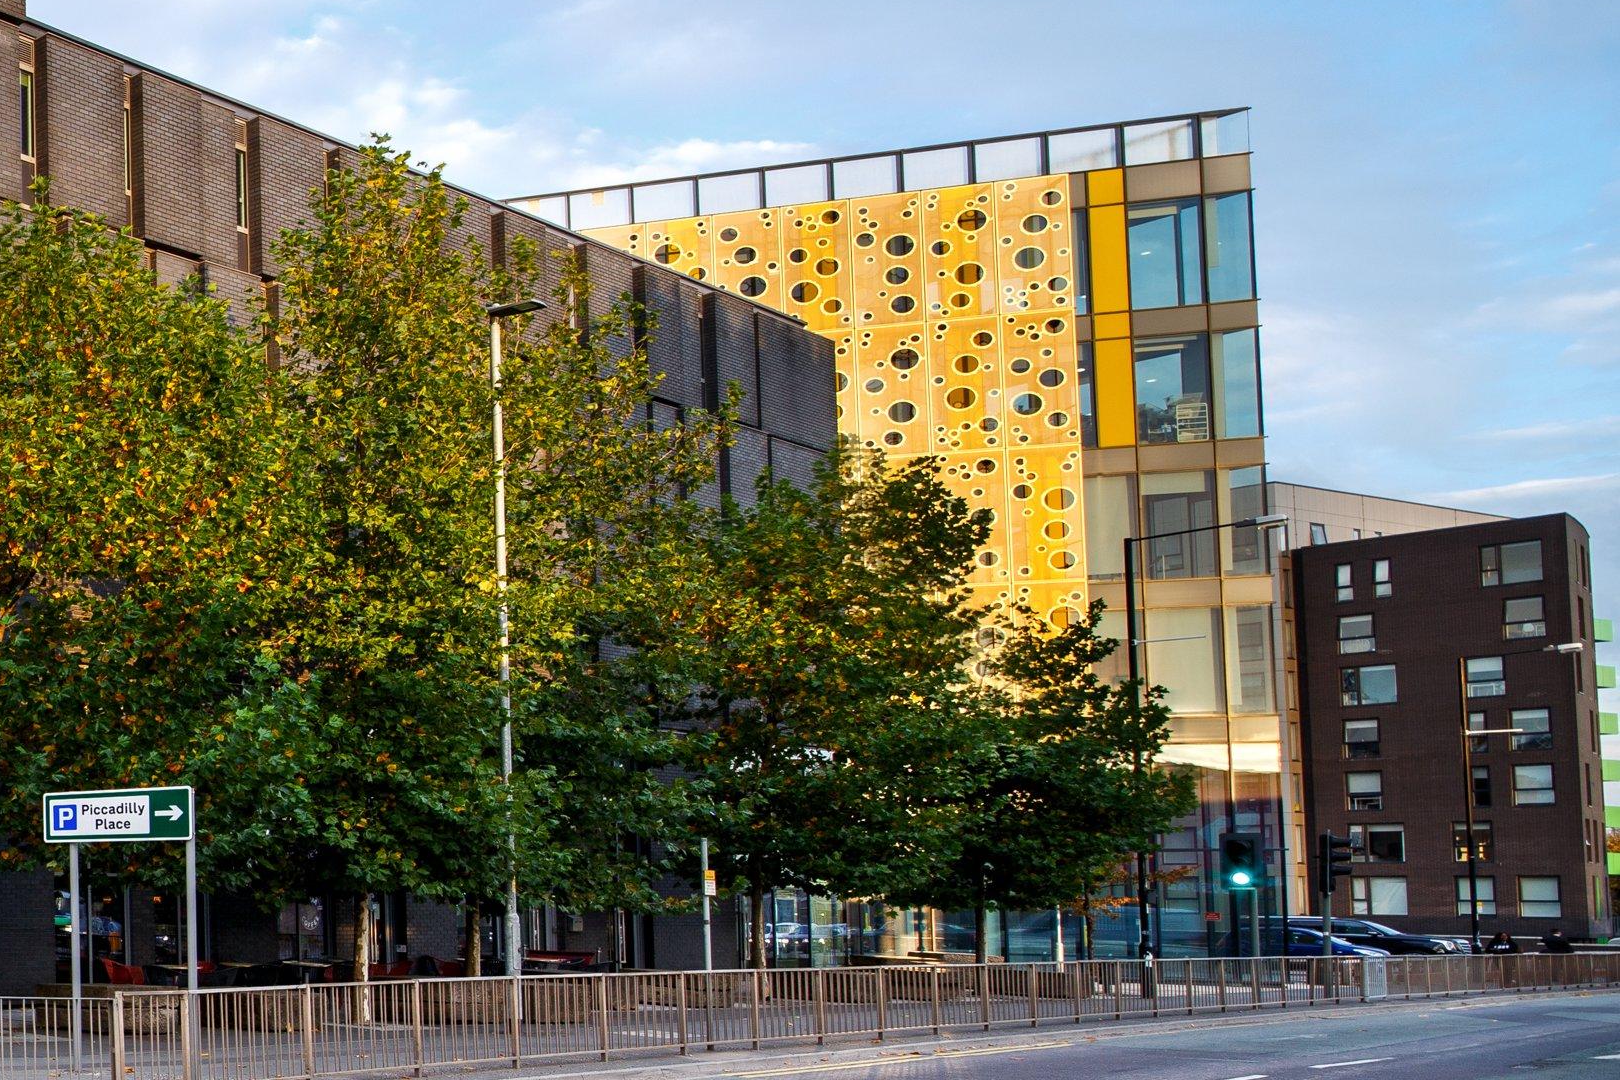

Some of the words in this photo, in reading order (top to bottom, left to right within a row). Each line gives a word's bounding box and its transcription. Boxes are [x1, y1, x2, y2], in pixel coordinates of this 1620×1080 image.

[59, 807, 74, 829] P
[81, 802, 145, 816] Piccadilly
[95, 818, 131, 830] Place
